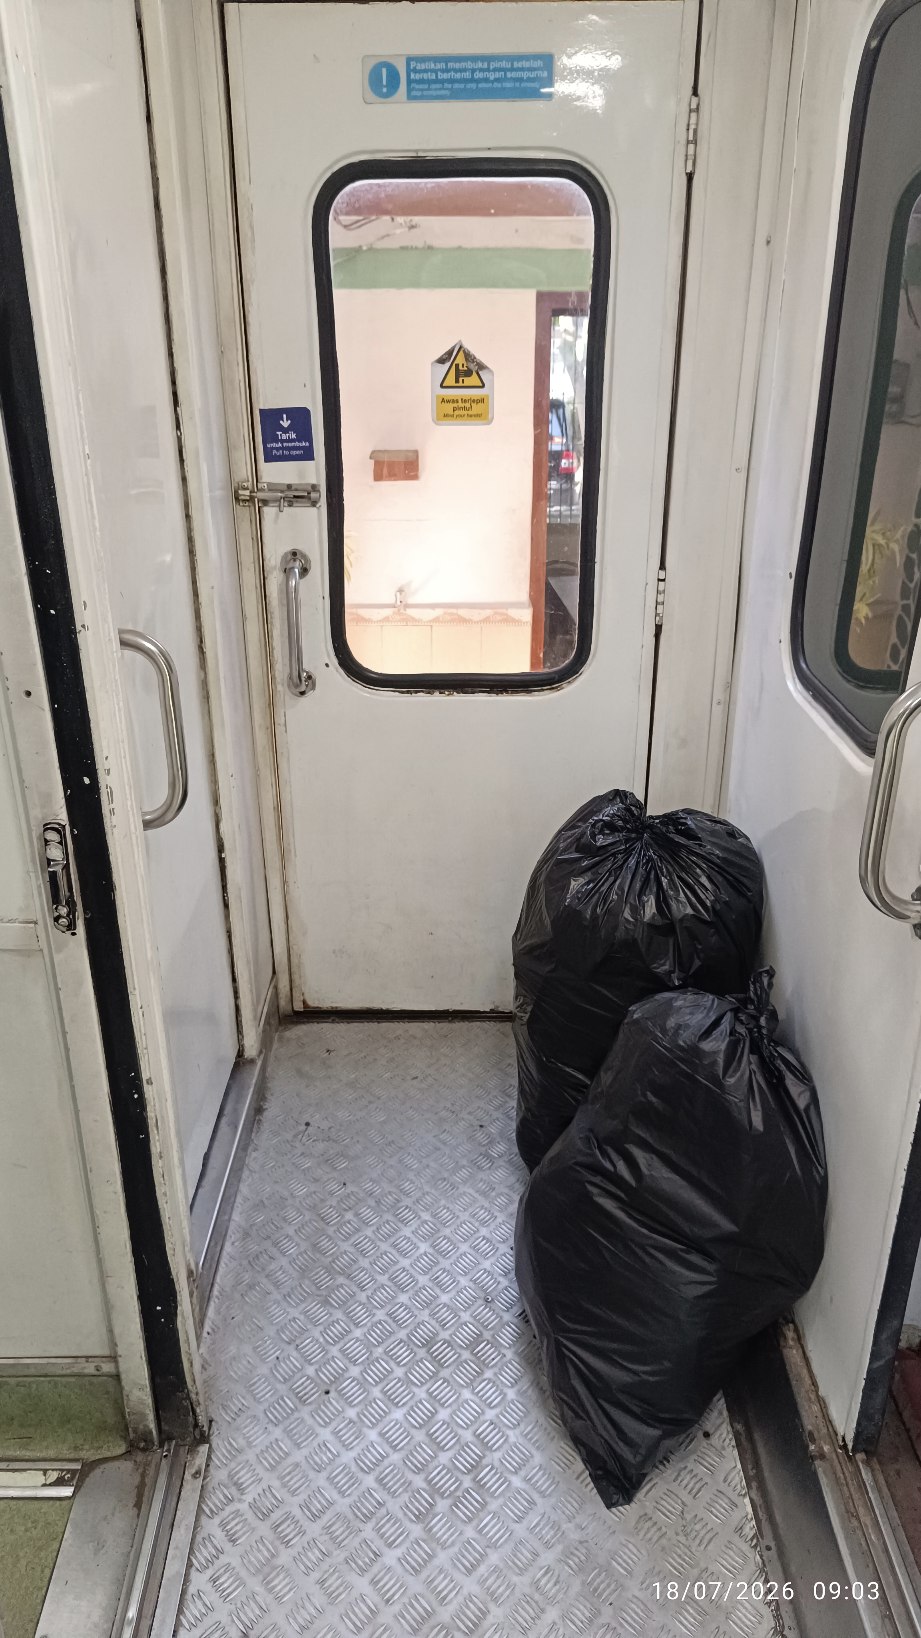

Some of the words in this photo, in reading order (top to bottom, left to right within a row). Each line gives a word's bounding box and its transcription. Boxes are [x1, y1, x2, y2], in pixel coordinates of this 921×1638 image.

[410, 61, 446, 70] Pastikan
[448, 60, 488, 69] membuka
[490, 60, 511, 71] pintu
[513, 59, 543, 68] setelah
[410, 71, 436, 80] kereta
[438, 70, 472, 79] berhenti
[473, 69, 505, 81] dengan
[506, 69, 548, 80] sempurna
[276, 431, 296, 439] Tarik
